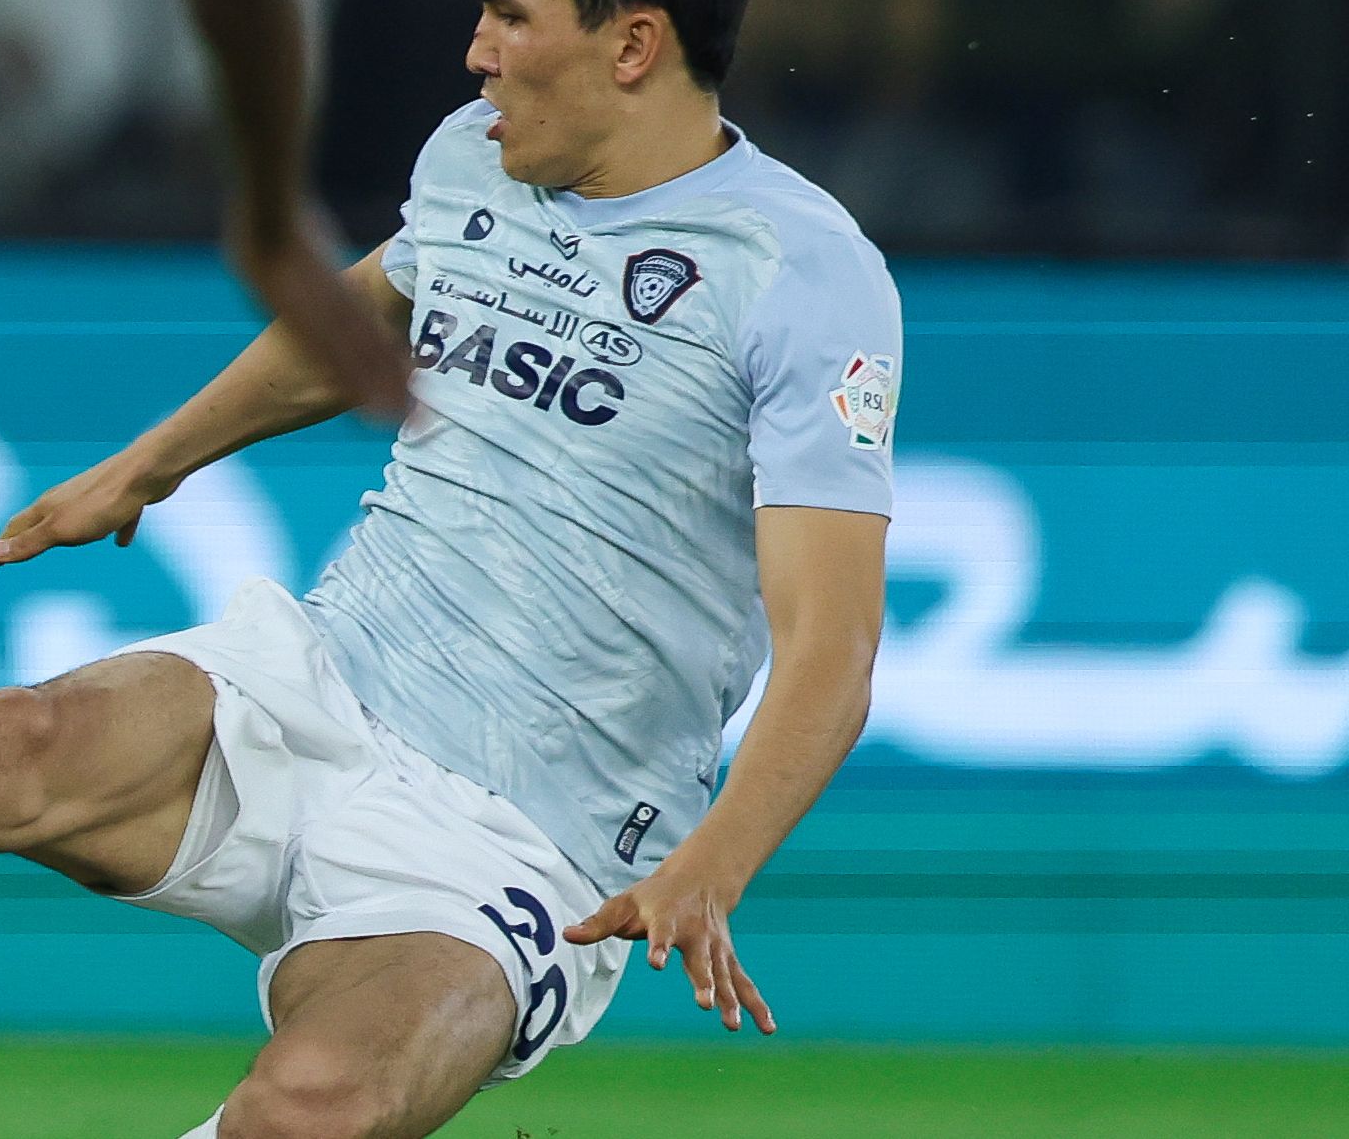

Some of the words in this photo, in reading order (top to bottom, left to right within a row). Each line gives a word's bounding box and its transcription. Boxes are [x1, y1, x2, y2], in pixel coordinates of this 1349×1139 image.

[415, 309, 625, 427] BASIC
[586, 331, 634, 358] AS
[863, 391, 885, 412] RSL
[477, 886, 568, 1061] 20
